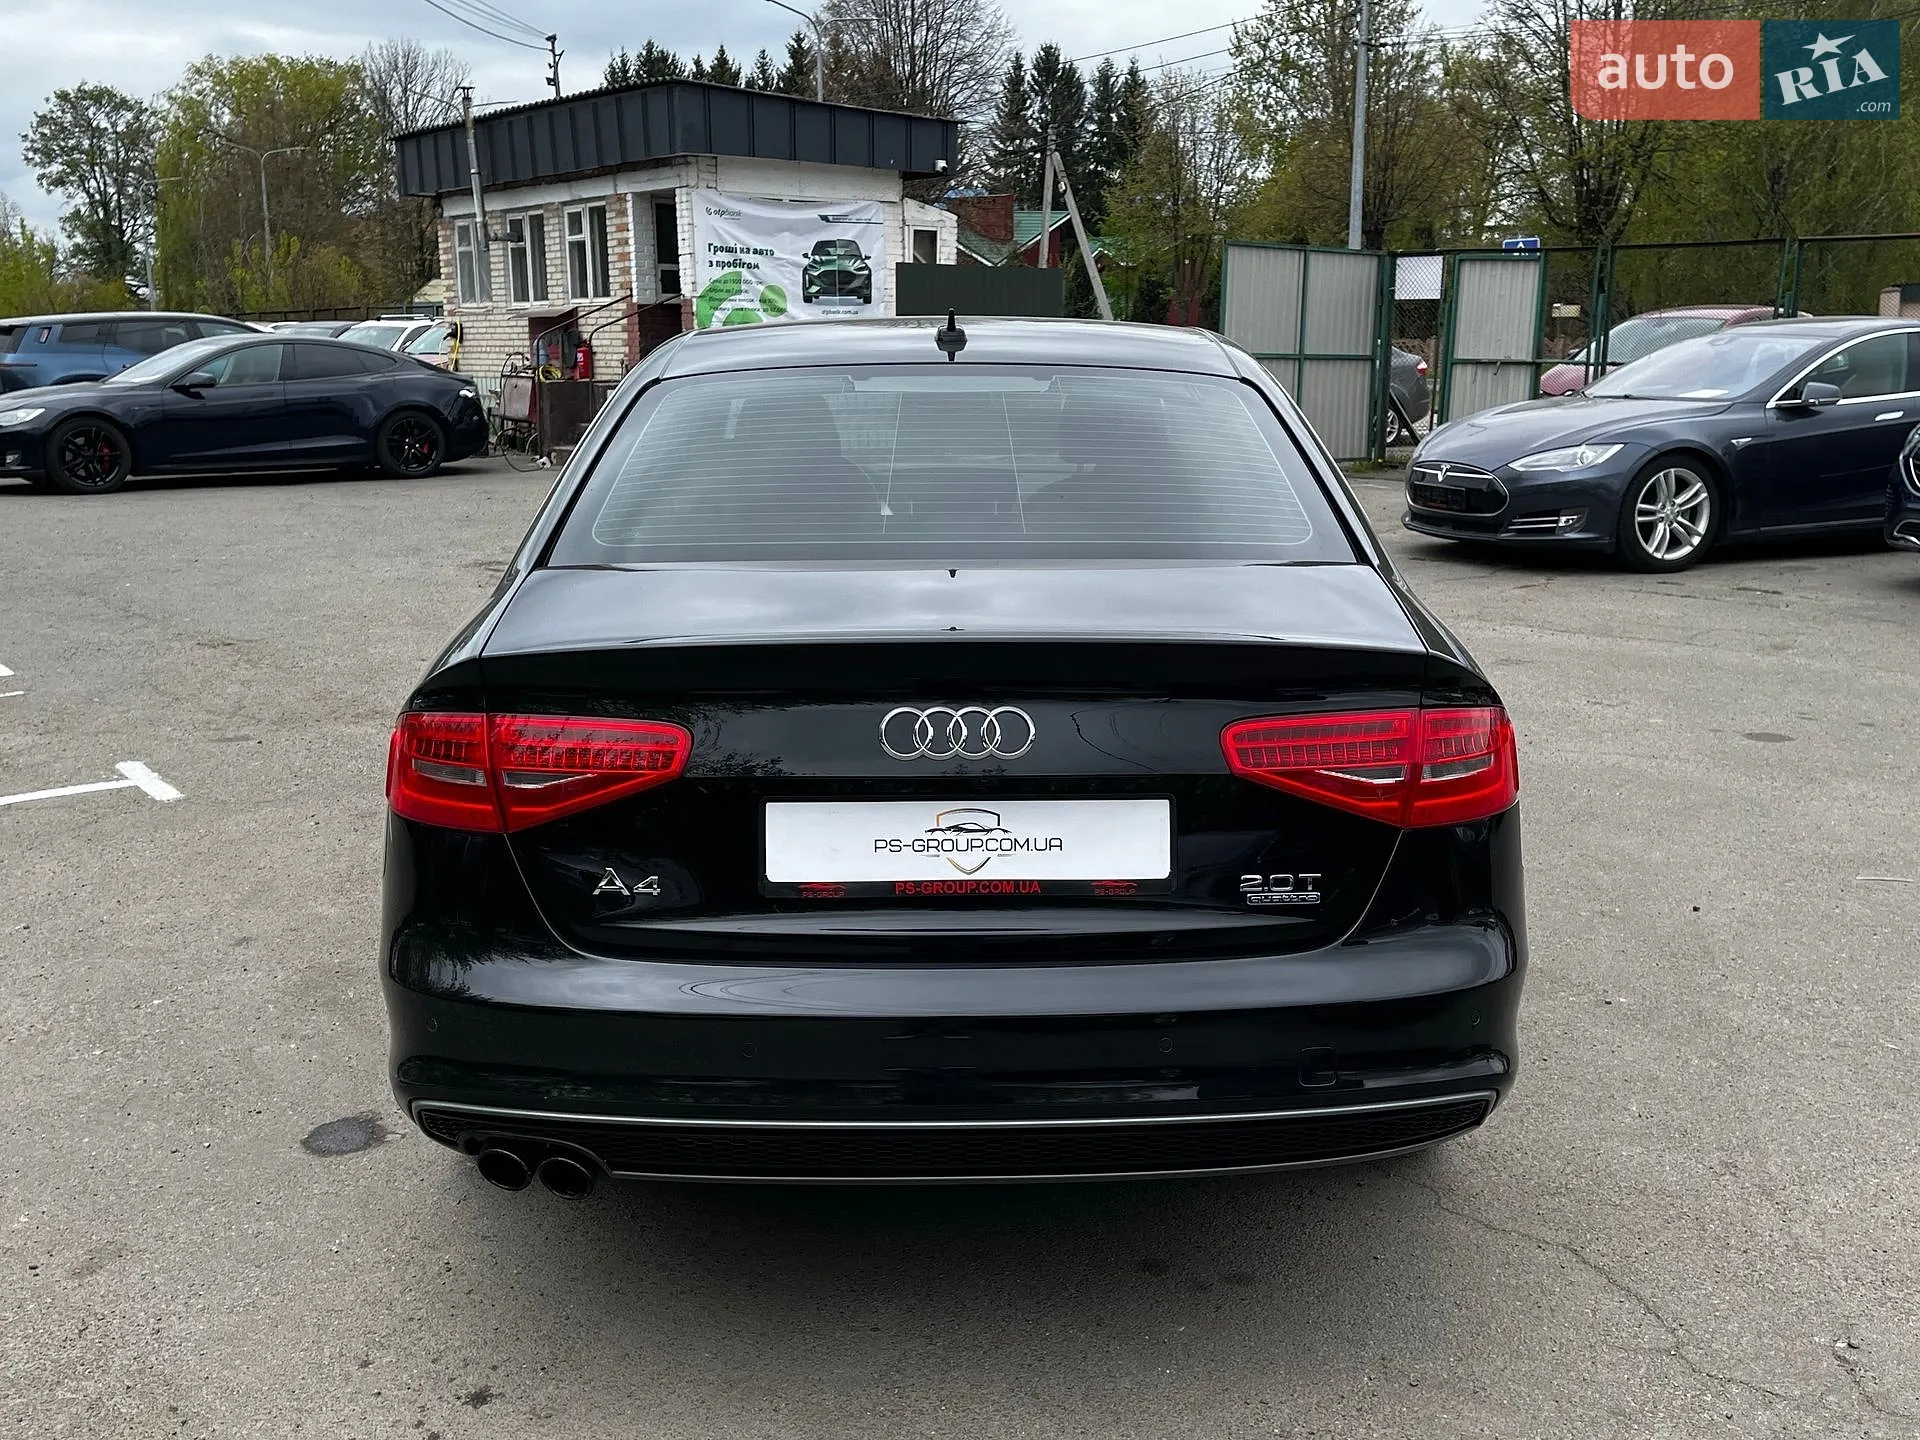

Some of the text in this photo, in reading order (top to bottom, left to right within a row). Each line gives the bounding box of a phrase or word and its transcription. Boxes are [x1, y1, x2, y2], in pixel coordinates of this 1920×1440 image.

[708, 243, 775, 256] Гроші на авто
[708, 258, 760, 271] з пробігом
[874, 837, 1063, 853] PS-GROUP.COM.UA
[592, 867, 662, 896] A4
[894, 880, 1042, 896] PS-GROUP.COM.UA
[1240, 873, 1321, 892] 2.0T
[1250, 894, 1318, 904] quattro
